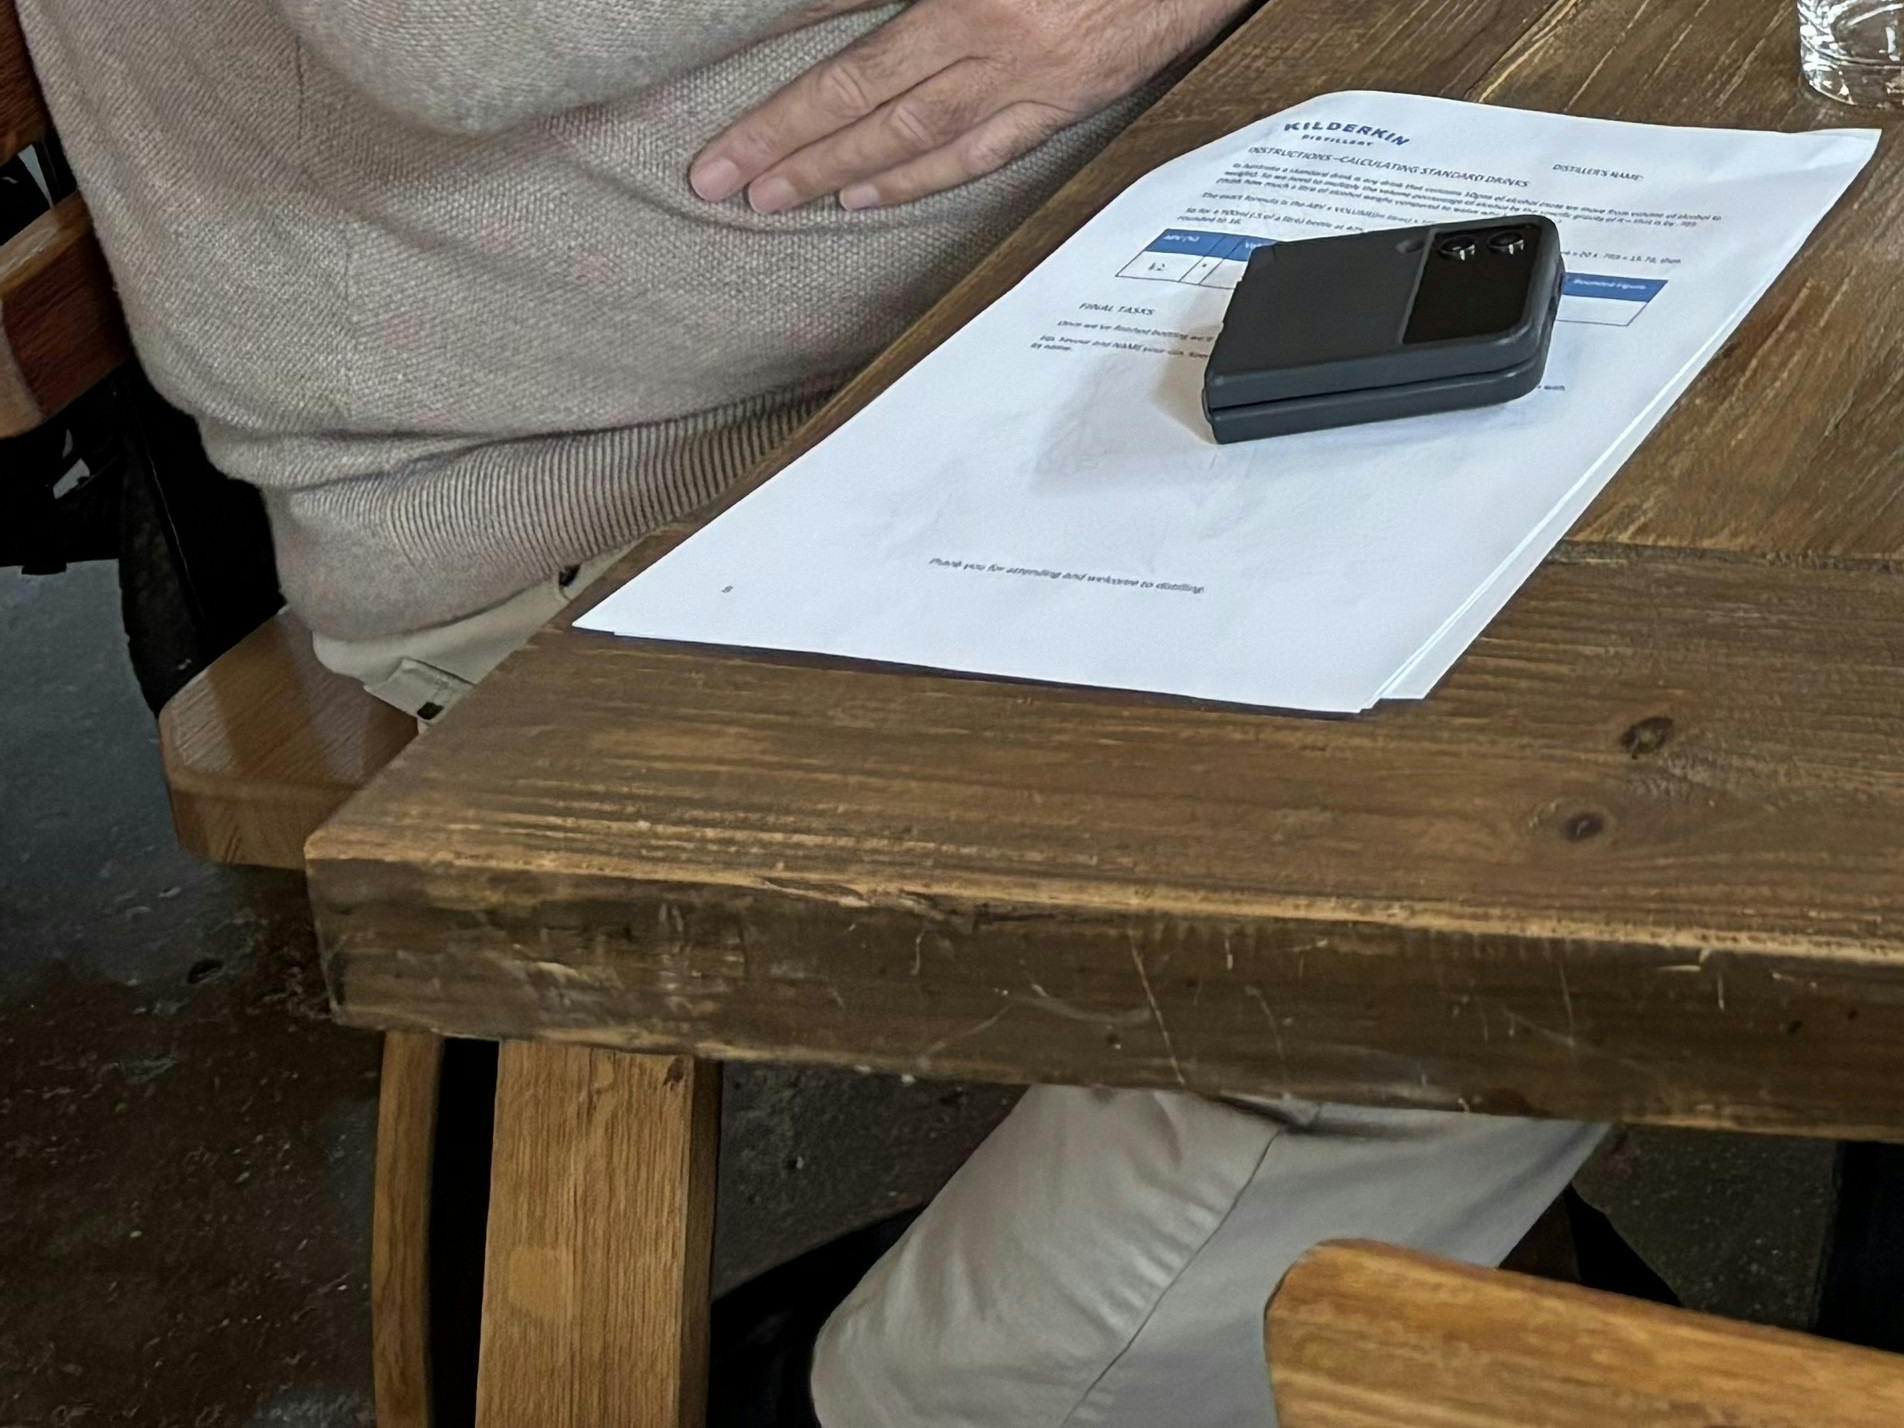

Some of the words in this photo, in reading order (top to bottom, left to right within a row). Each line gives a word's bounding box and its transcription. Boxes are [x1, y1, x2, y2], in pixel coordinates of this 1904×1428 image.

[1283, 121, 1410, 145] KILDERKIN
[1248, 147, 1331, 161] INSTRUCTIONS
[1420, 167, 1485, 182] STANDARD
[1485, 175, 1529, 188] DRINKS
[1079, 302, 1115, 312] FINAL
[1118, 304, 1156, 316] TASKS
